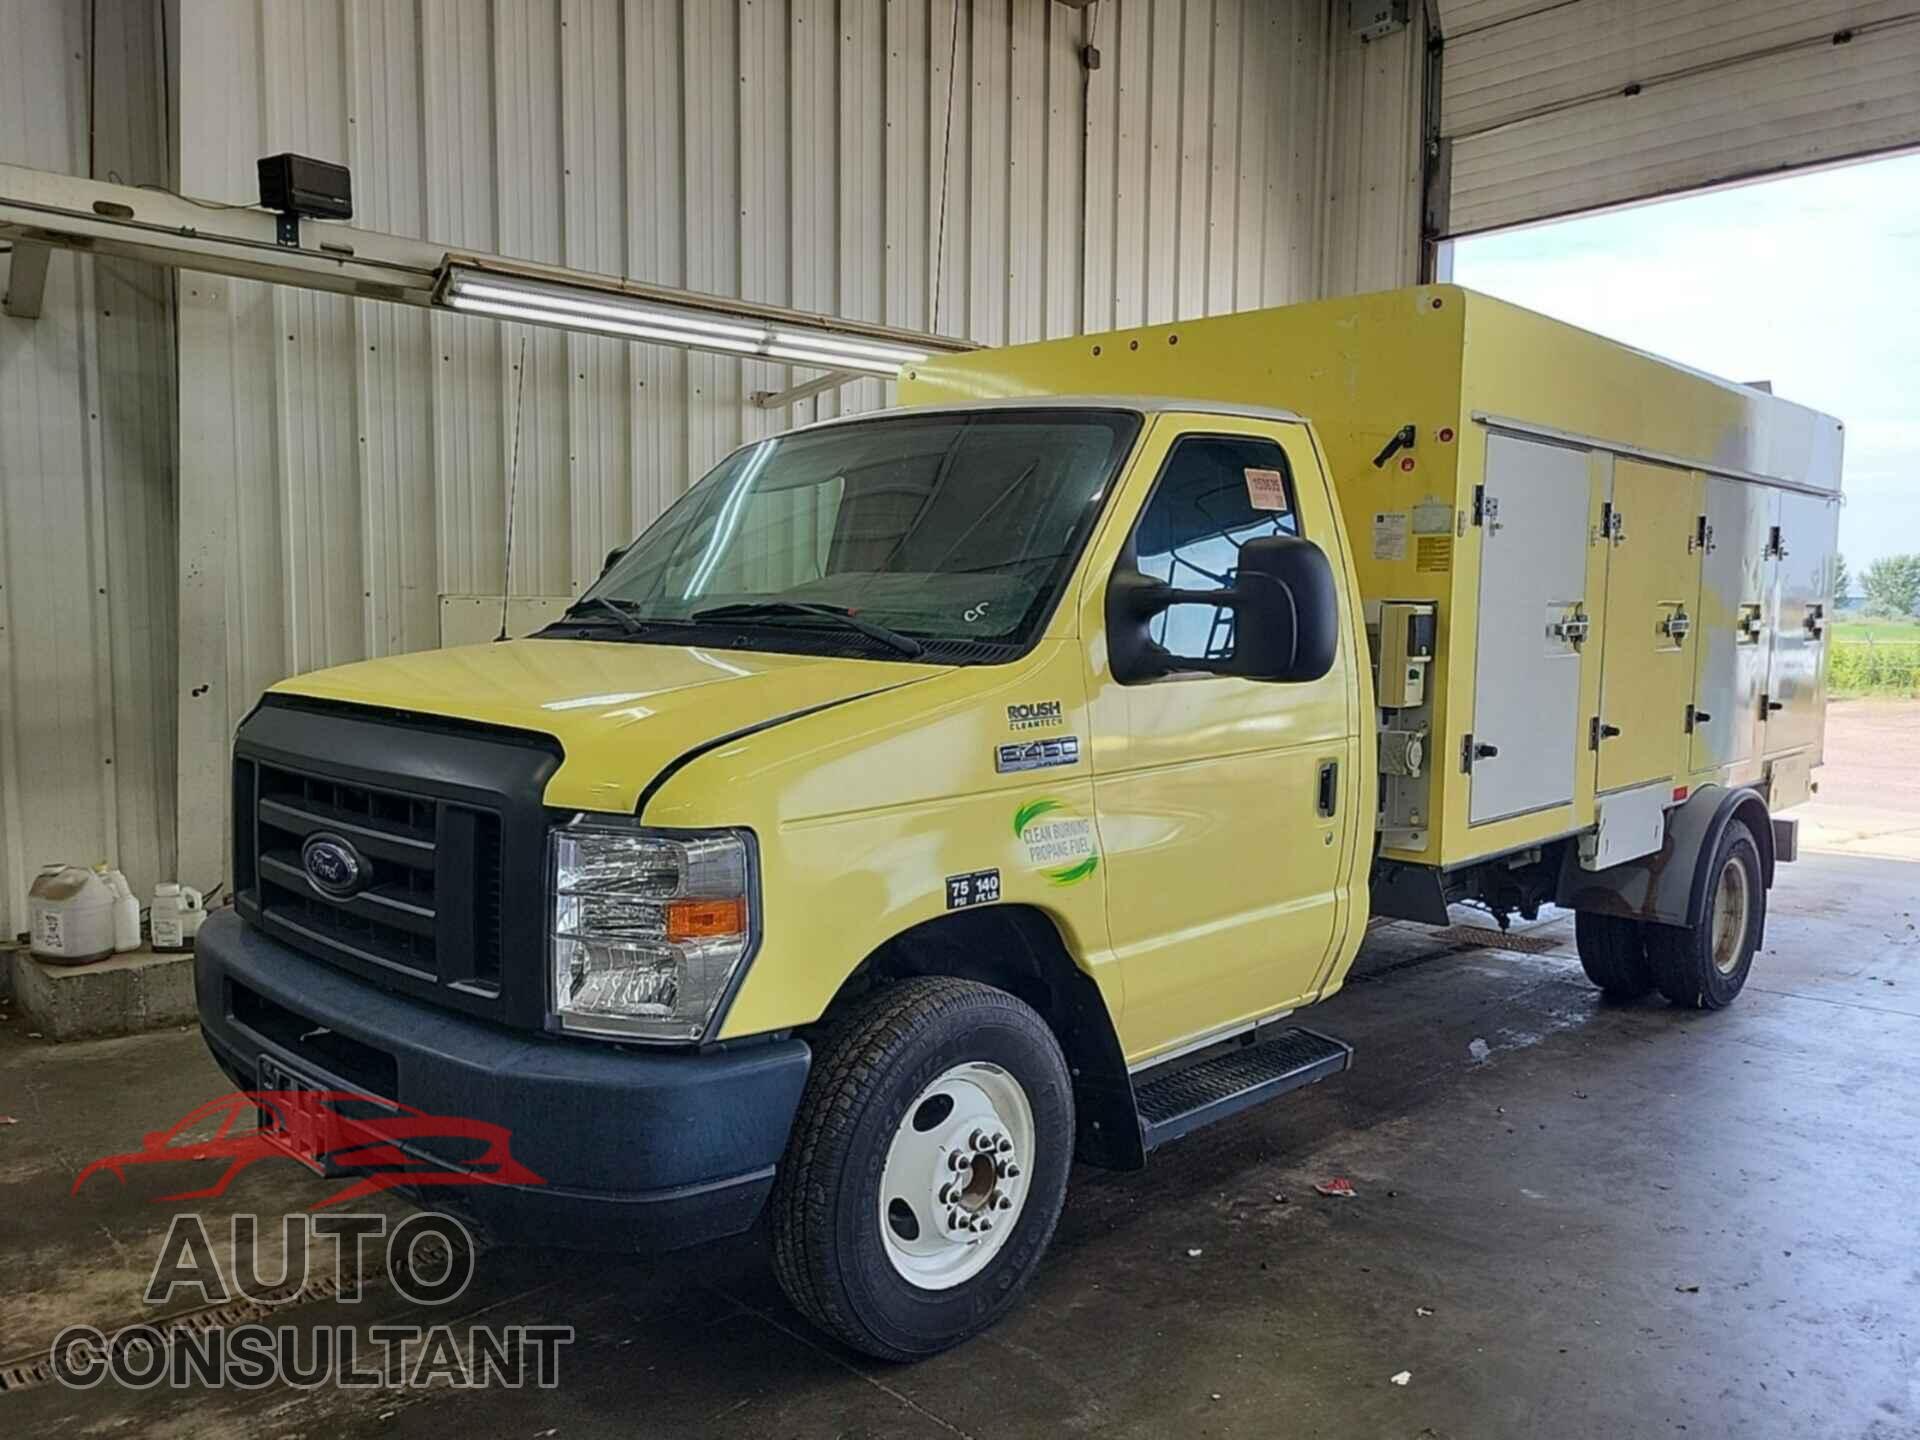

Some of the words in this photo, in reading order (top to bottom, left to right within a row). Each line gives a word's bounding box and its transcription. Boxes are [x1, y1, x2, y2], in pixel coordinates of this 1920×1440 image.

[1008, 701, 1061, 718] ROUSH
[1009, 719, 1062, 730] CLEANTECH
[1024, 825, 1052, 844] CLEAN
[1053, 819, 1089, 840] BURNING
[1029, 842, 1068, 862] PROPANE
[1069, 838, 1090, 854] FUEL
[951, 880, 969, 897] 75
[975, 876, 998, 892] 140
